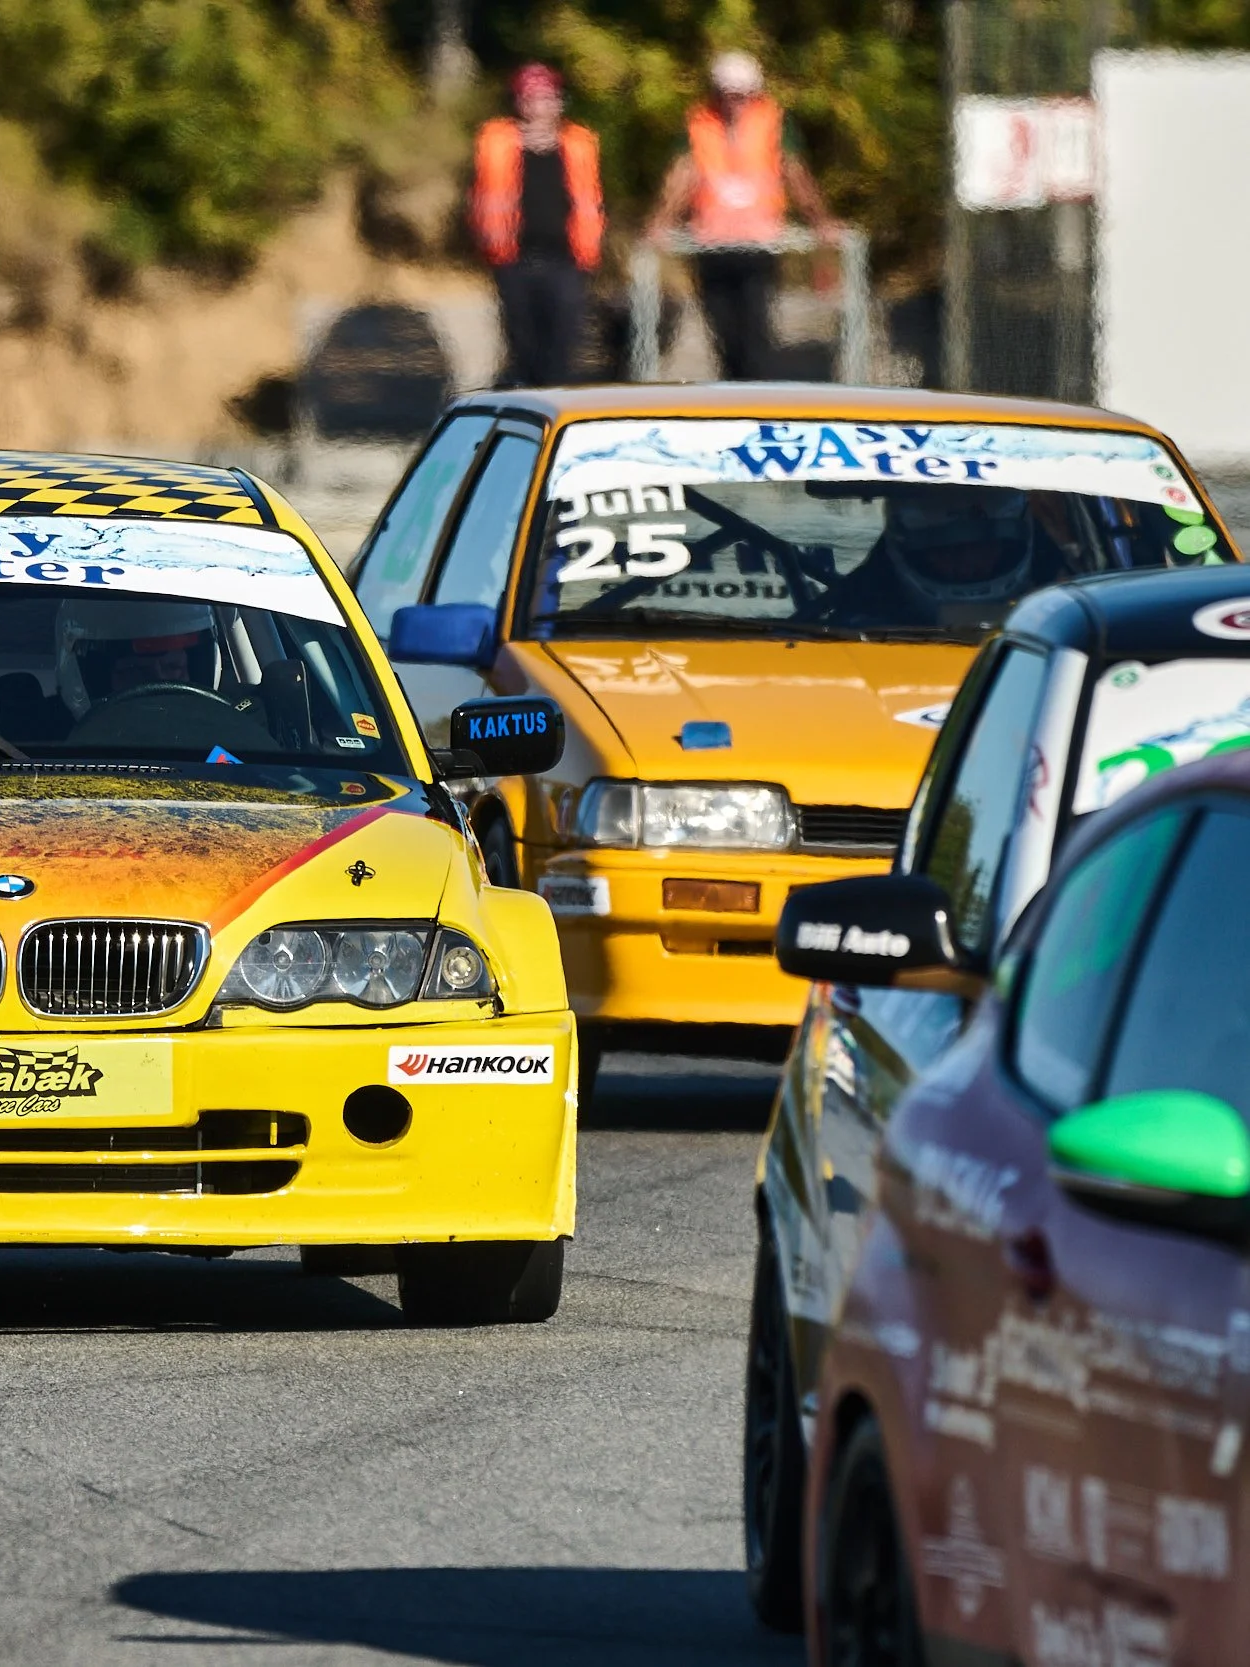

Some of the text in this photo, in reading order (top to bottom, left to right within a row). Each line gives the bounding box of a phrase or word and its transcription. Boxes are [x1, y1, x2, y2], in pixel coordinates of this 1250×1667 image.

[556, 523, 692, 583] 25
[469, 711, 548, 740] KAKTUS
[15, 1094, 61, 1117] Cars
